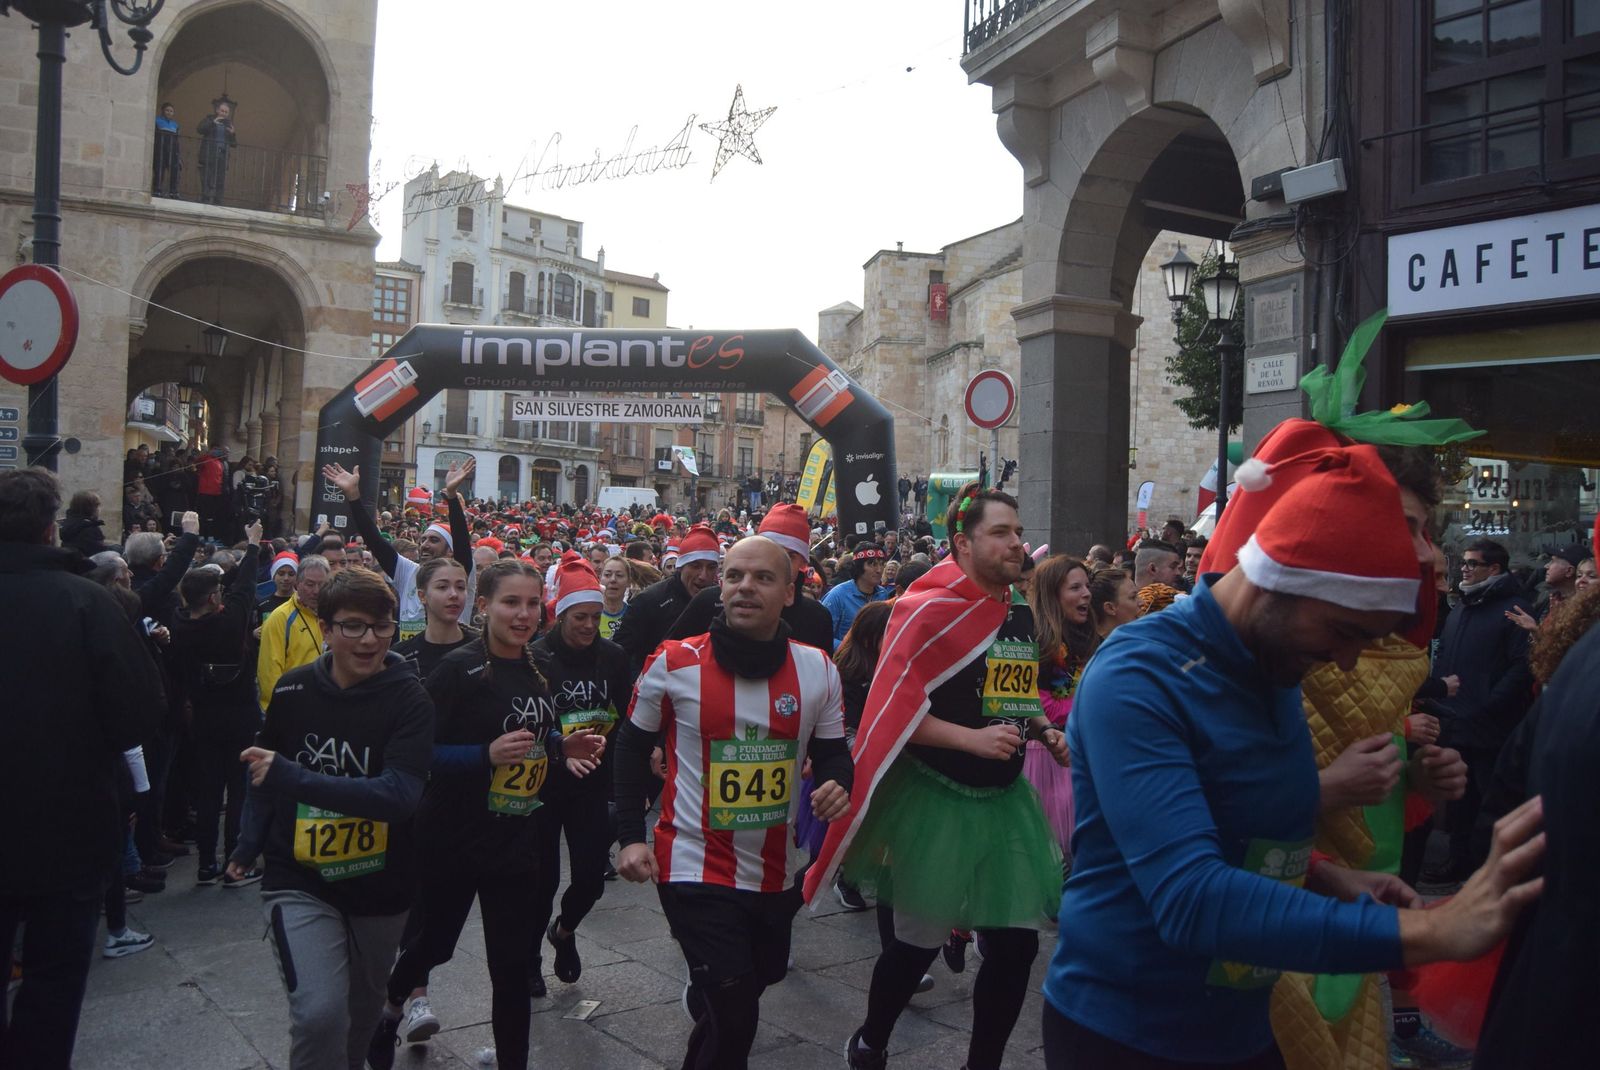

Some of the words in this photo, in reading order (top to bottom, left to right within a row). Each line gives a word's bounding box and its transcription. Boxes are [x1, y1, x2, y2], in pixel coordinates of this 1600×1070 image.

[1408, 227, 1600, 292] CAFETE
[461, 329, 745, 376] implantes
[1260, 369, 1270, 379] DE
[1273, 367, 1282, 377] LA
[1263, 359, 1284, 369] CALLE
[531, 377, 565, 388] oral
[585, 377, 669, 391] implantes
[672, 379, 747, 390] dentales
[1257, 378, 1284, 388] RENOVA
[515, 401, 542, 415] SAN
[548, 402, 619, 417] SILVESTRE
[624, 403, 702, 418] ZAMORANA
[993, 663, 1033, 694] 1239
[304, 732, 370, 775] SAN
[739, 752, 760, 762] CAJA
[762, 750, 787, 761] RURAL
[719, 767, 787, 803] 643
[736, 813, 760, 823] CAJA
[762, 809, 787, 822] RURAL
[304, 820, 375, 858] 1278
[321, 865, 347, 877] CAJA
[348, 858, 381, 873] RURAL
